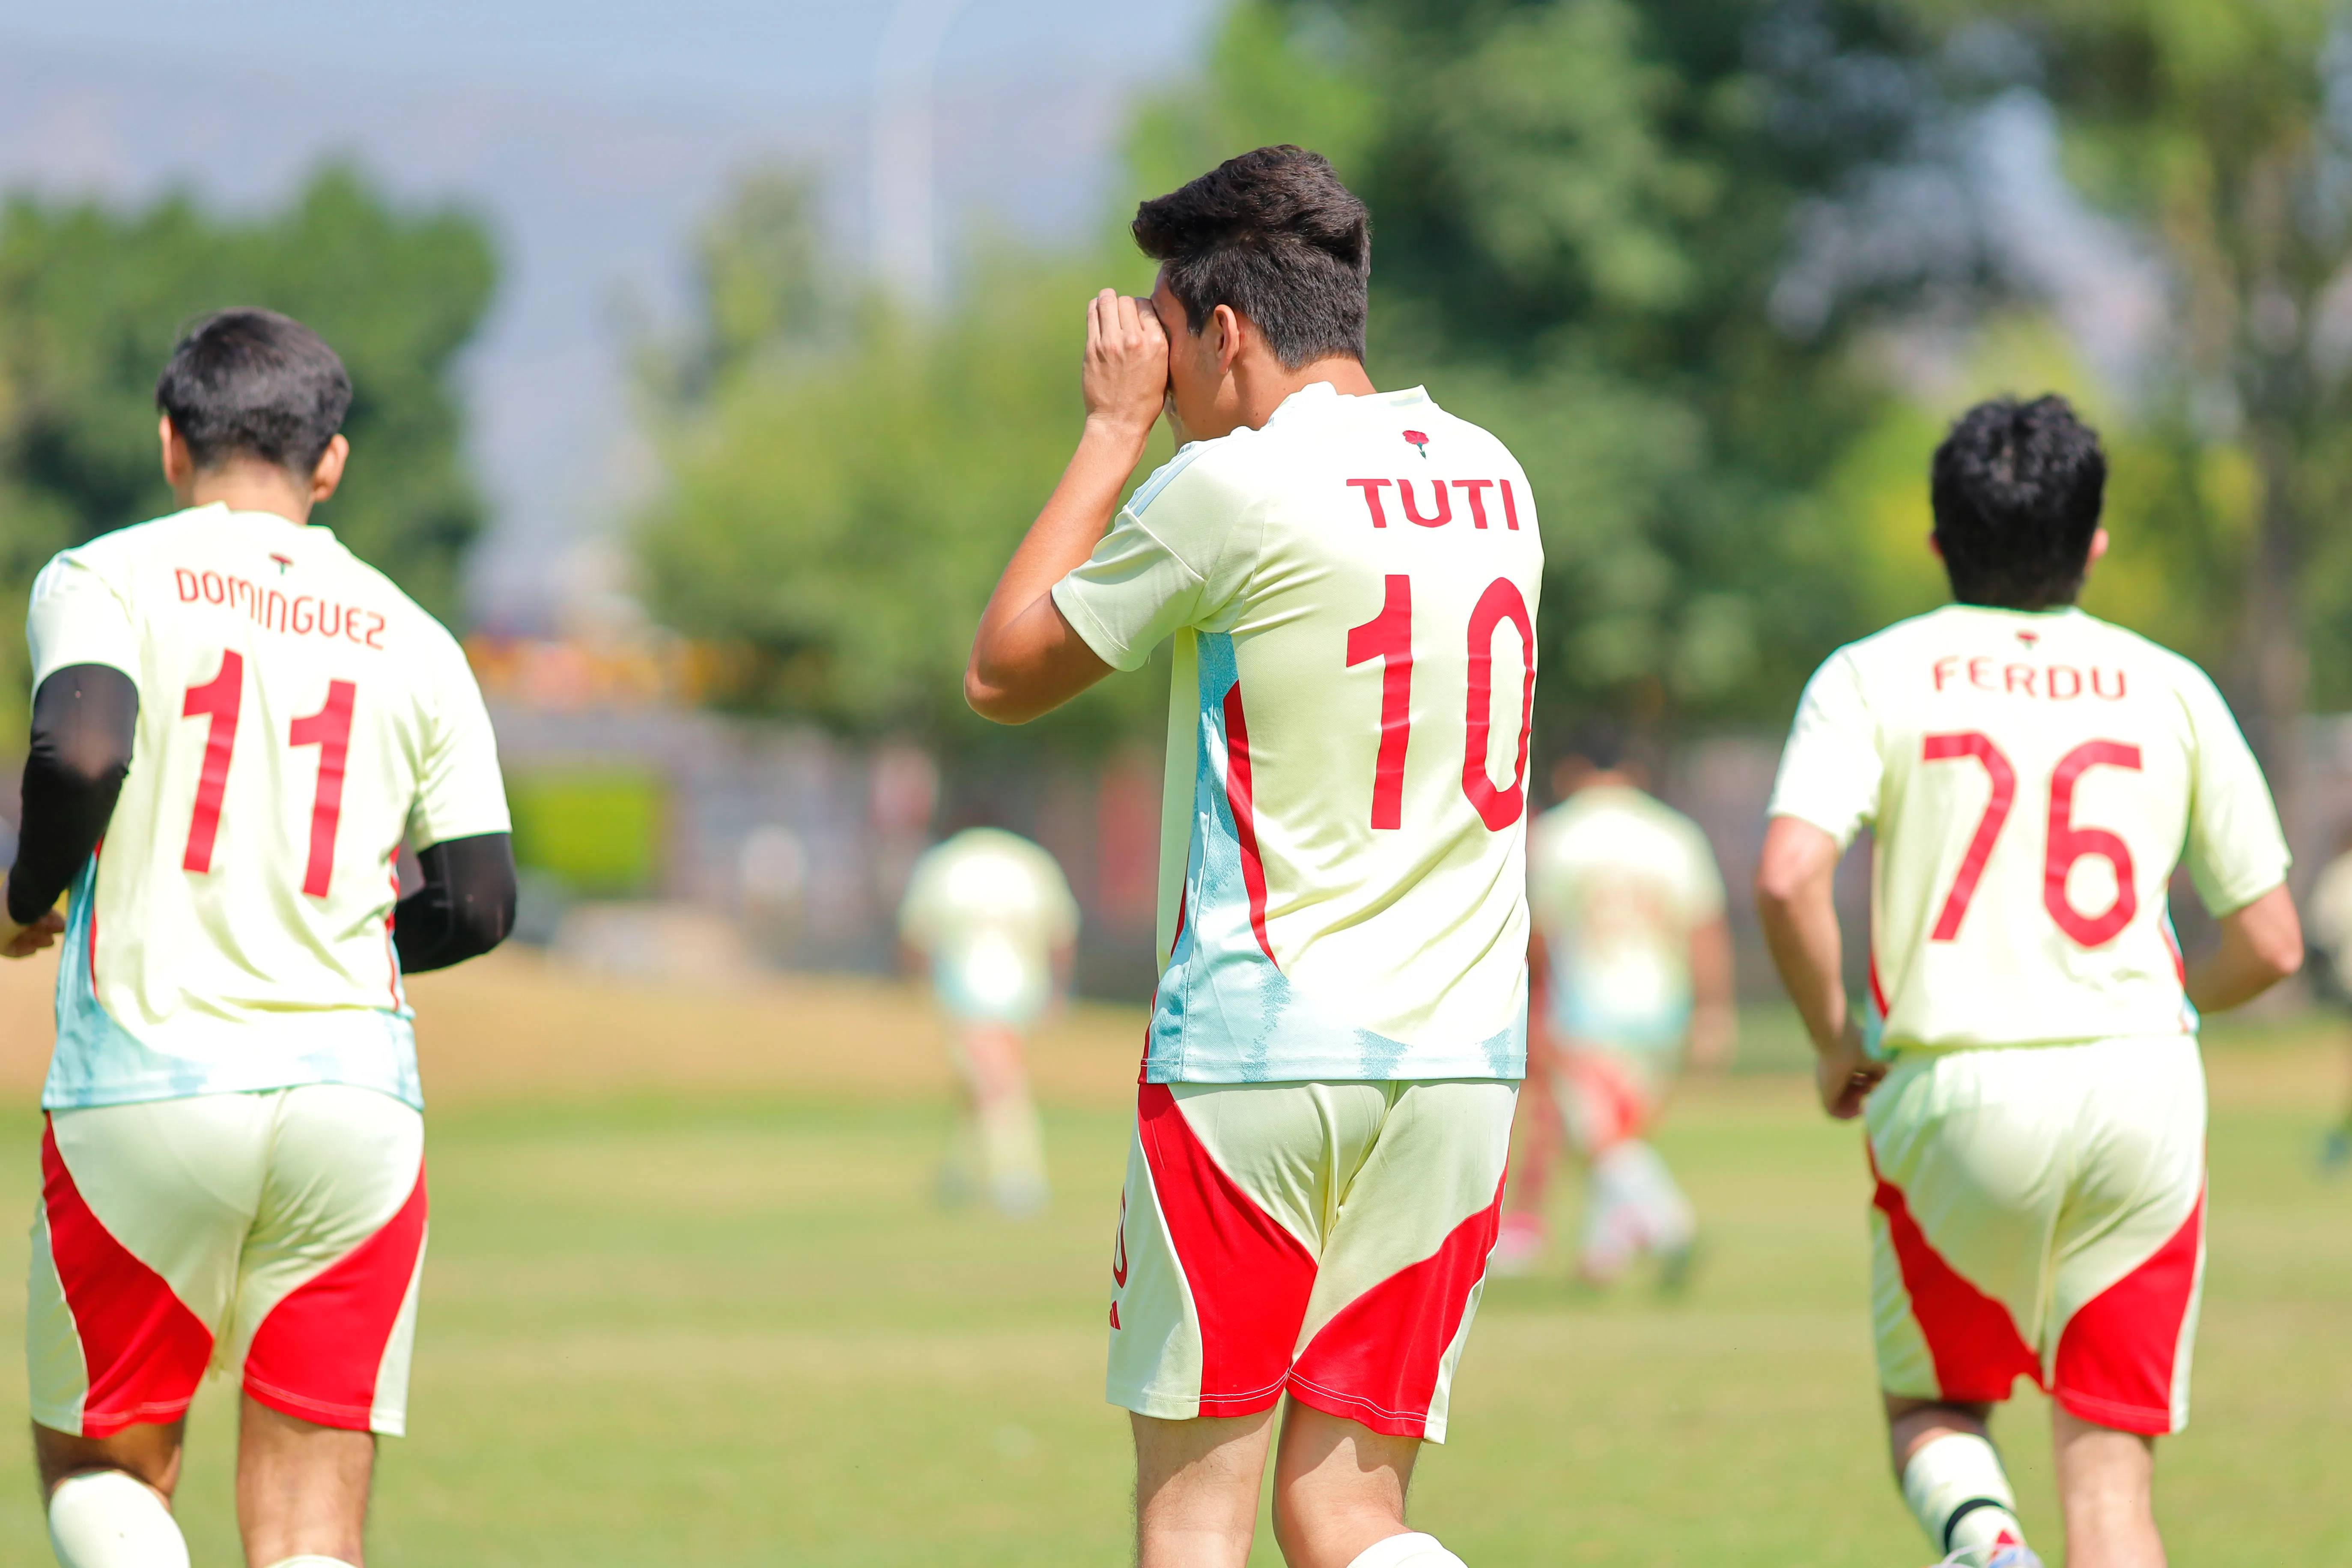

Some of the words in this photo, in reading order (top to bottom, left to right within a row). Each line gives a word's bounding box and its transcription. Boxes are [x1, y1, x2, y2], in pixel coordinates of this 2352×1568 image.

[1346, 478, 1520, 531] TUTI
[174, 566, 386, 652] DOMINGUEZ
[1932, 654, 2127, 702] FERDU
[182, 648, 357, 900] 11
[1346, 574, 1536, 832] 10
[1921, 730, 2143, 949] 76
